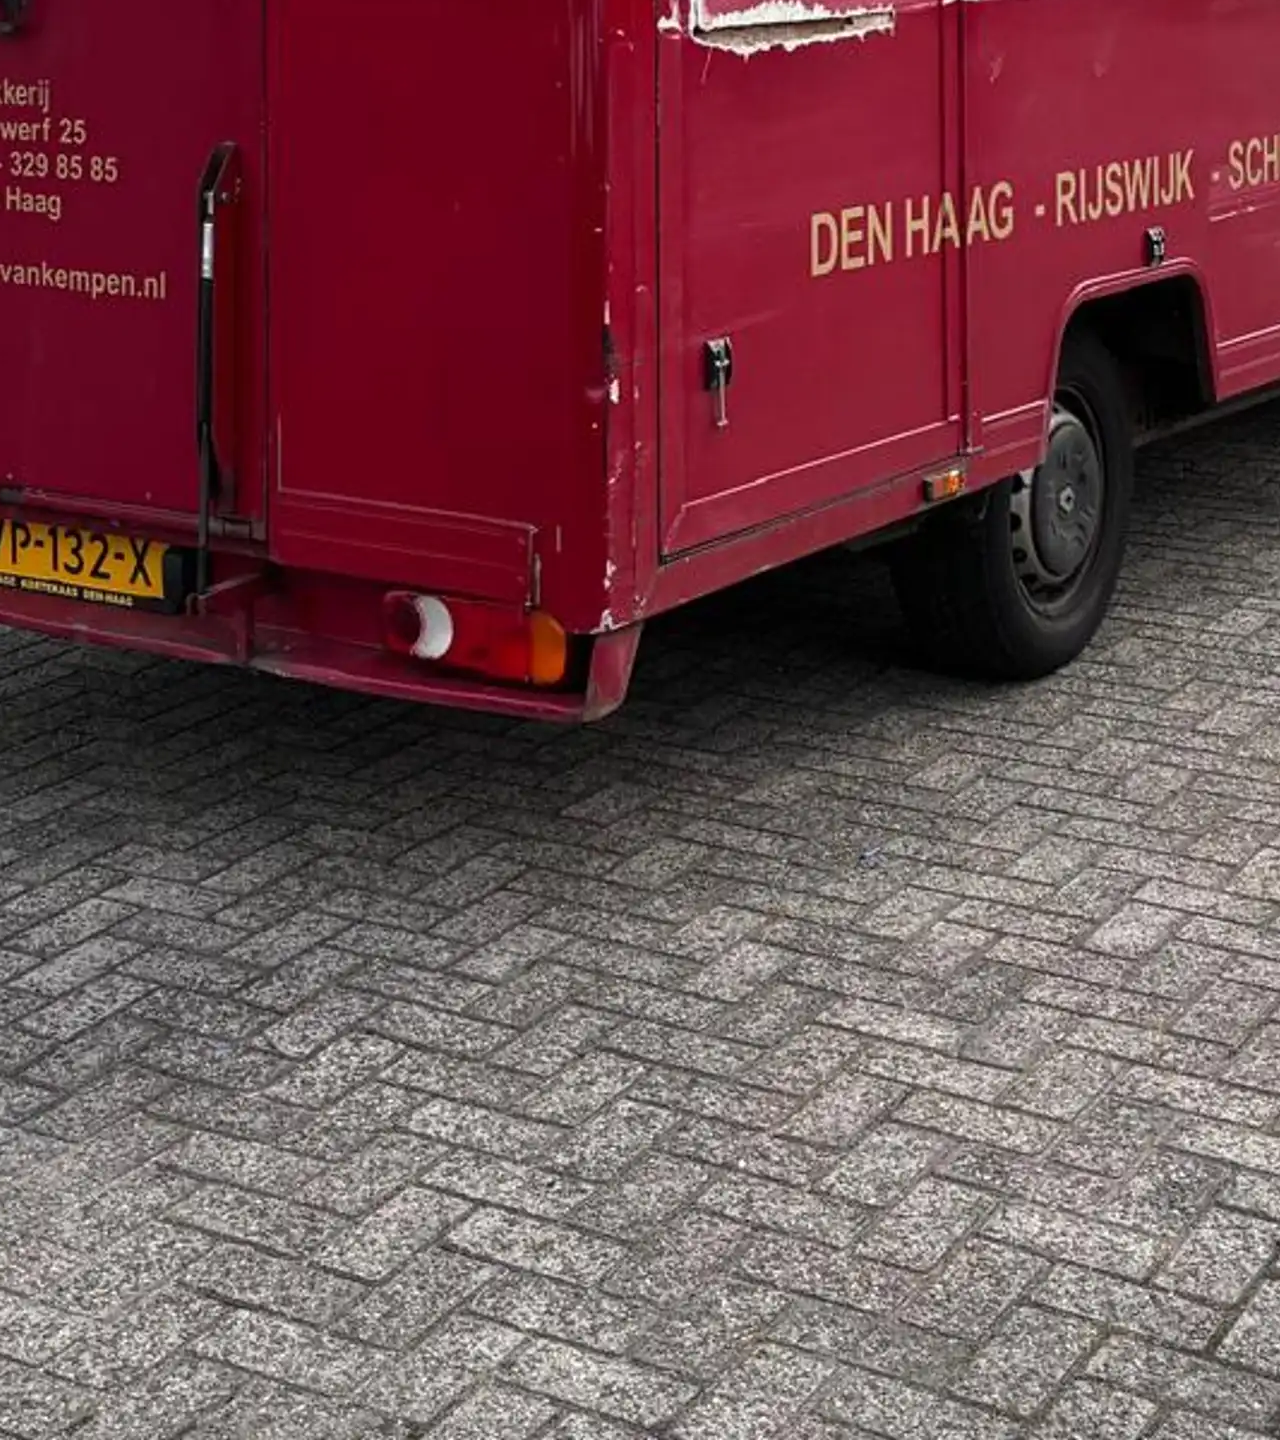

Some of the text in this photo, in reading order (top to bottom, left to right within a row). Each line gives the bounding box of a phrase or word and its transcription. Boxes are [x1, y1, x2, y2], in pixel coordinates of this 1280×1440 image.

[59, 119, 87, 145] 25
[10, 151, 48, 178] 329
[56, 156, 82, 180] 85
[90, 157, 118, 182] 85
[6, 186, 62, 221] Haag
[810, 202, 894, 277] DEN
[904, 180, 1014, 257] HAAG
[1055, 150, 1194, 226] RIJSWIJK
